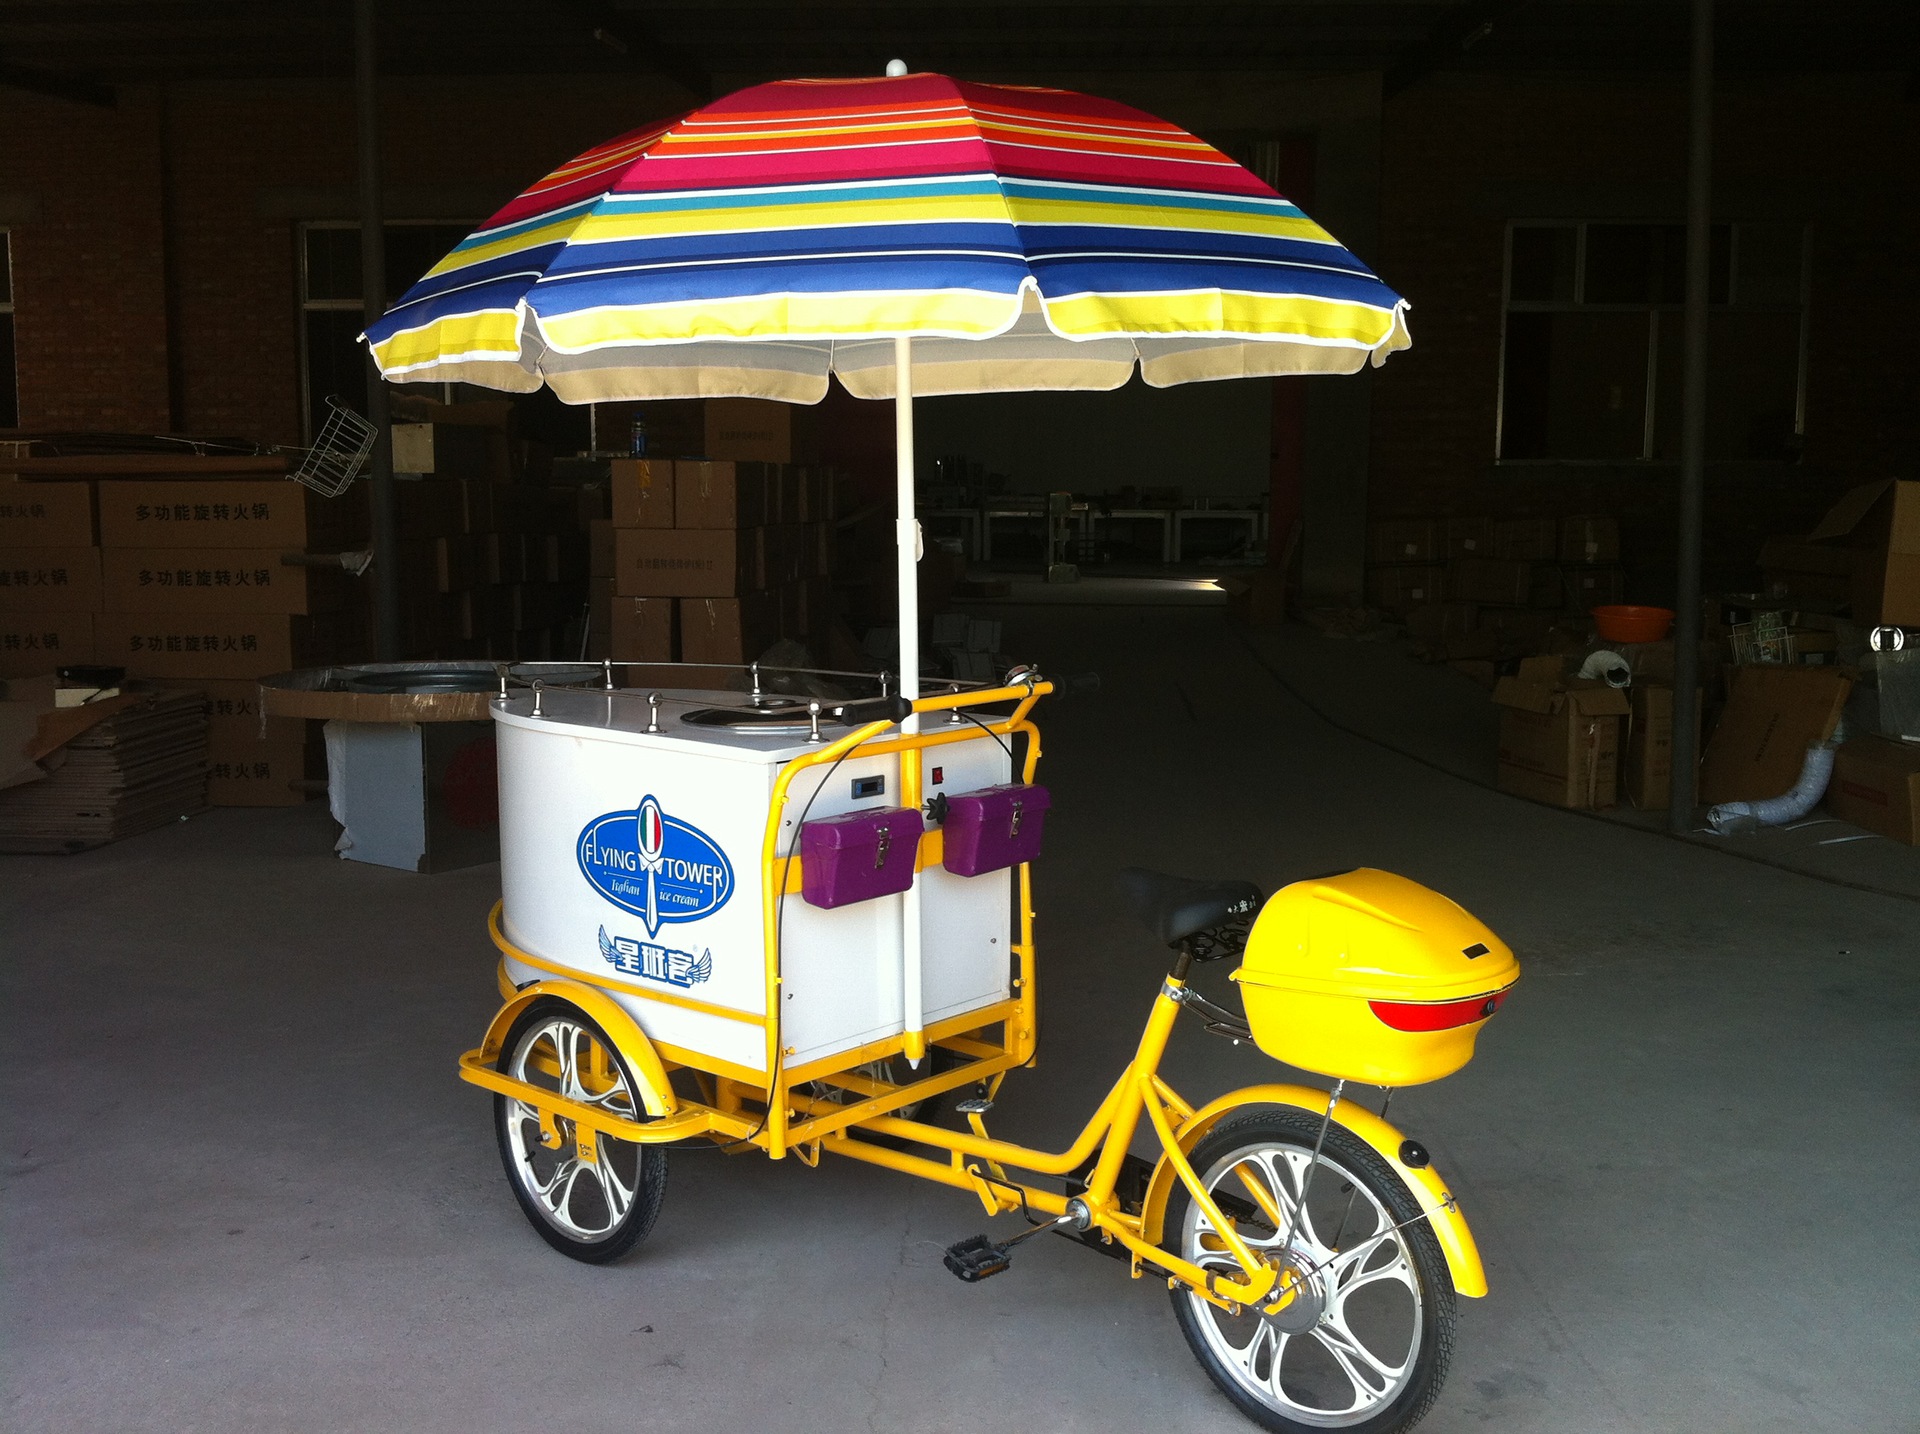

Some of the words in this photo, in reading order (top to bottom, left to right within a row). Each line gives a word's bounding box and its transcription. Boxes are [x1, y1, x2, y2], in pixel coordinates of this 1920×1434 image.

[135, 503, 270, 521] 多功能旋转火锅
[139, 569, 271, 587] 多功能旋转火锅
[129, 635, 258, 652] 多功能旋转火锅
[585, 843, 637, 872] FLYING
[664, 857, 724, 888] TOWER
[659, 888, 671, 902] ice
[672, 894, 700, 908] cream
